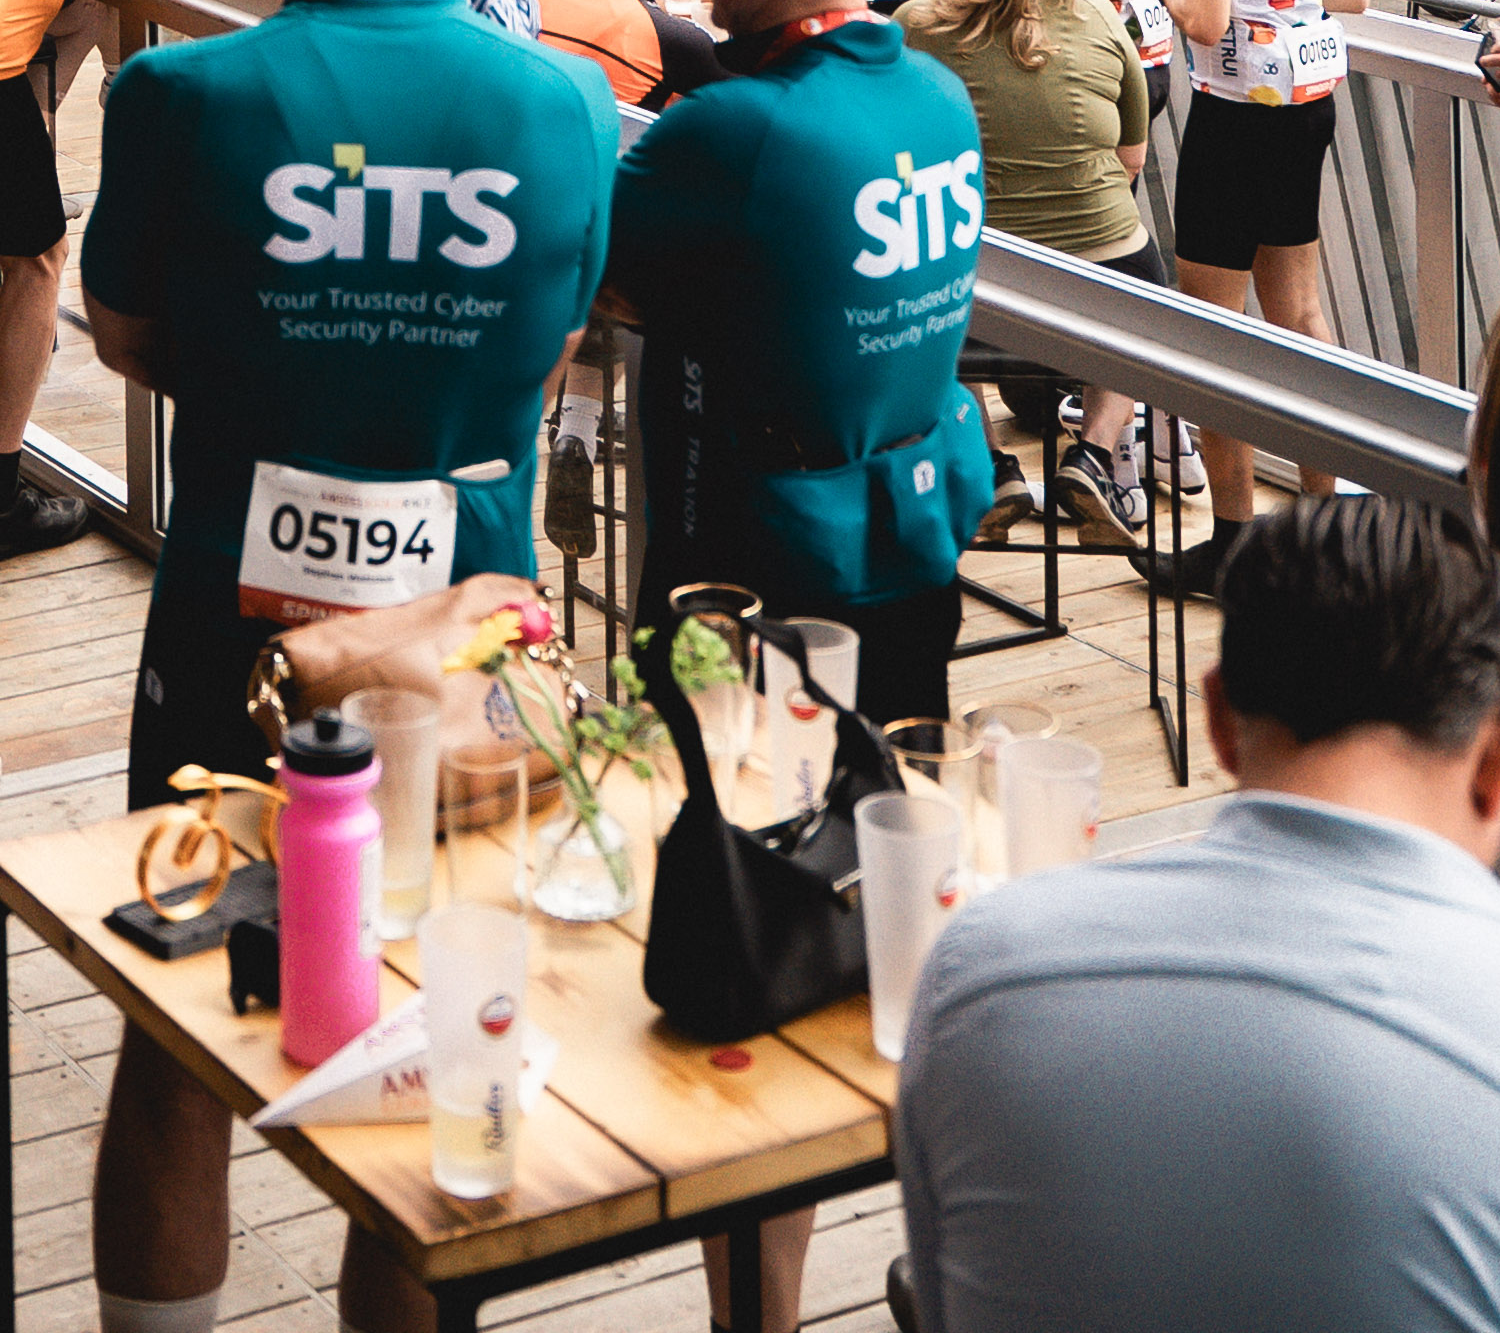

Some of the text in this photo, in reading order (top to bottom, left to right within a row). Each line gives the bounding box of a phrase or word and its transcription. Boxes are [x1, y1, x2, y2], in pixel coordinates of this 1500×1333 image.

[1299, 37, 1337, 66] 00189
[257, 286, 506, 321] Your Trusted Cyber
[843, 304, 889, 328] Your
[278, 317, 482, 347] Security Partner
[268, 502, 435, 568] 05194
